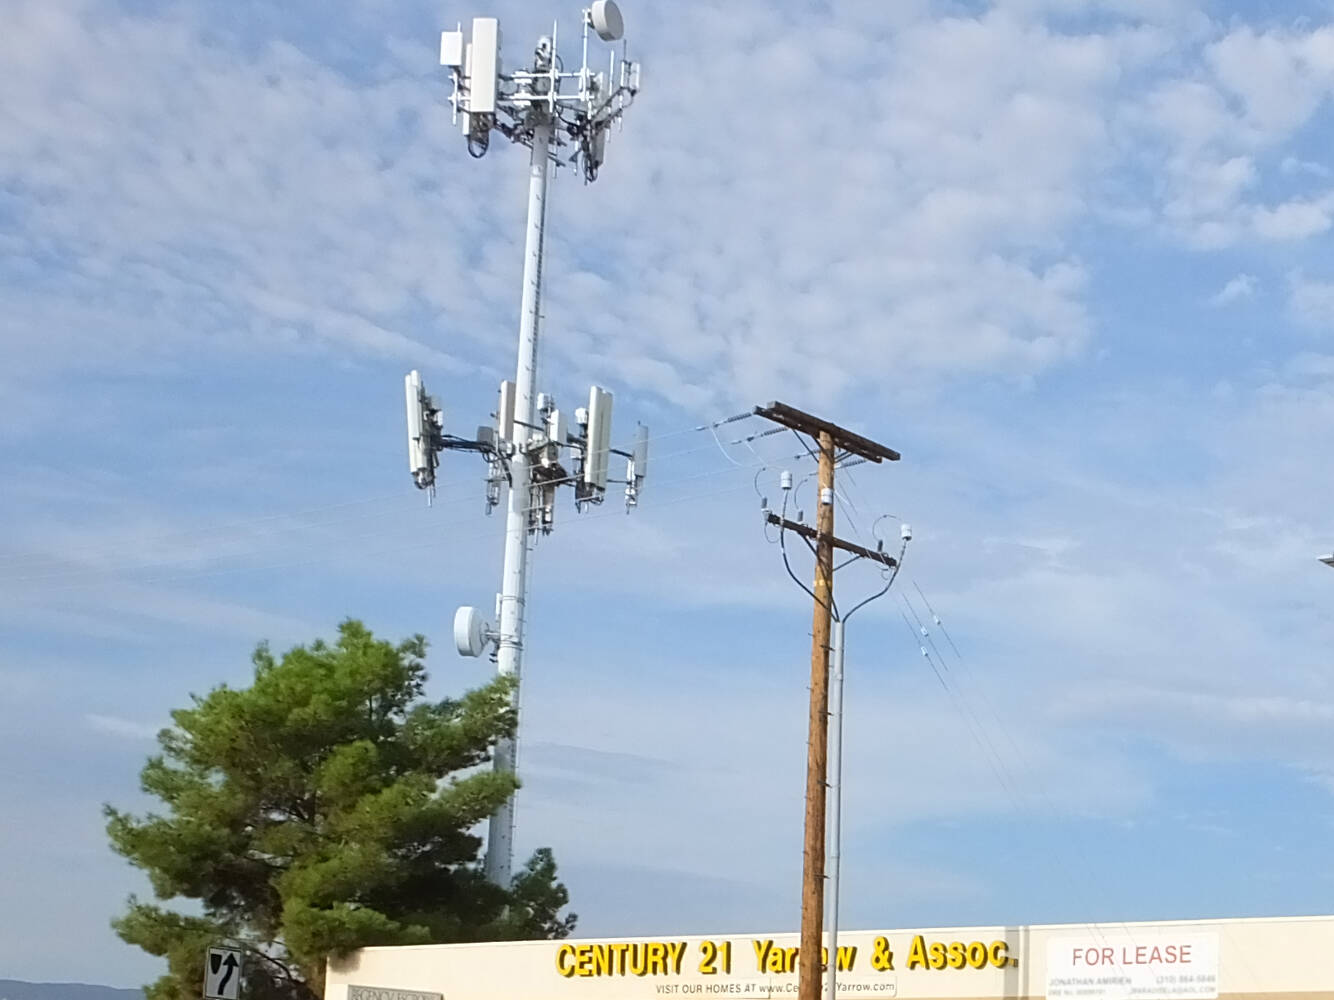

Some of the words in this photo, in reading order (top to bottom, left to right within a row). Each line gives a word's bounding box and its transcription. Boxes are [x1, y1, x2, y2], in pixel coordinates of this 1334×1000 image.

[556, 941, 687, 977] CENTURY
[698, 940, 731, 974] 21
[752, 940, 858, 974] Yarw
[871, 936, 895, 972] &
[907, 934, 1018, 970] Assoc.
[1072, 947, 1115, 966] FOR
[1122, 945, 1192, 965] LEASE
[656, 984, 679, 994] VISIT
[682, 984, 703, 994] OUR
[706, 983, 741, 994] HOMES
[743, 983, 756, 993] AT
[1049, 977, 1094, 986] JONATHAN
